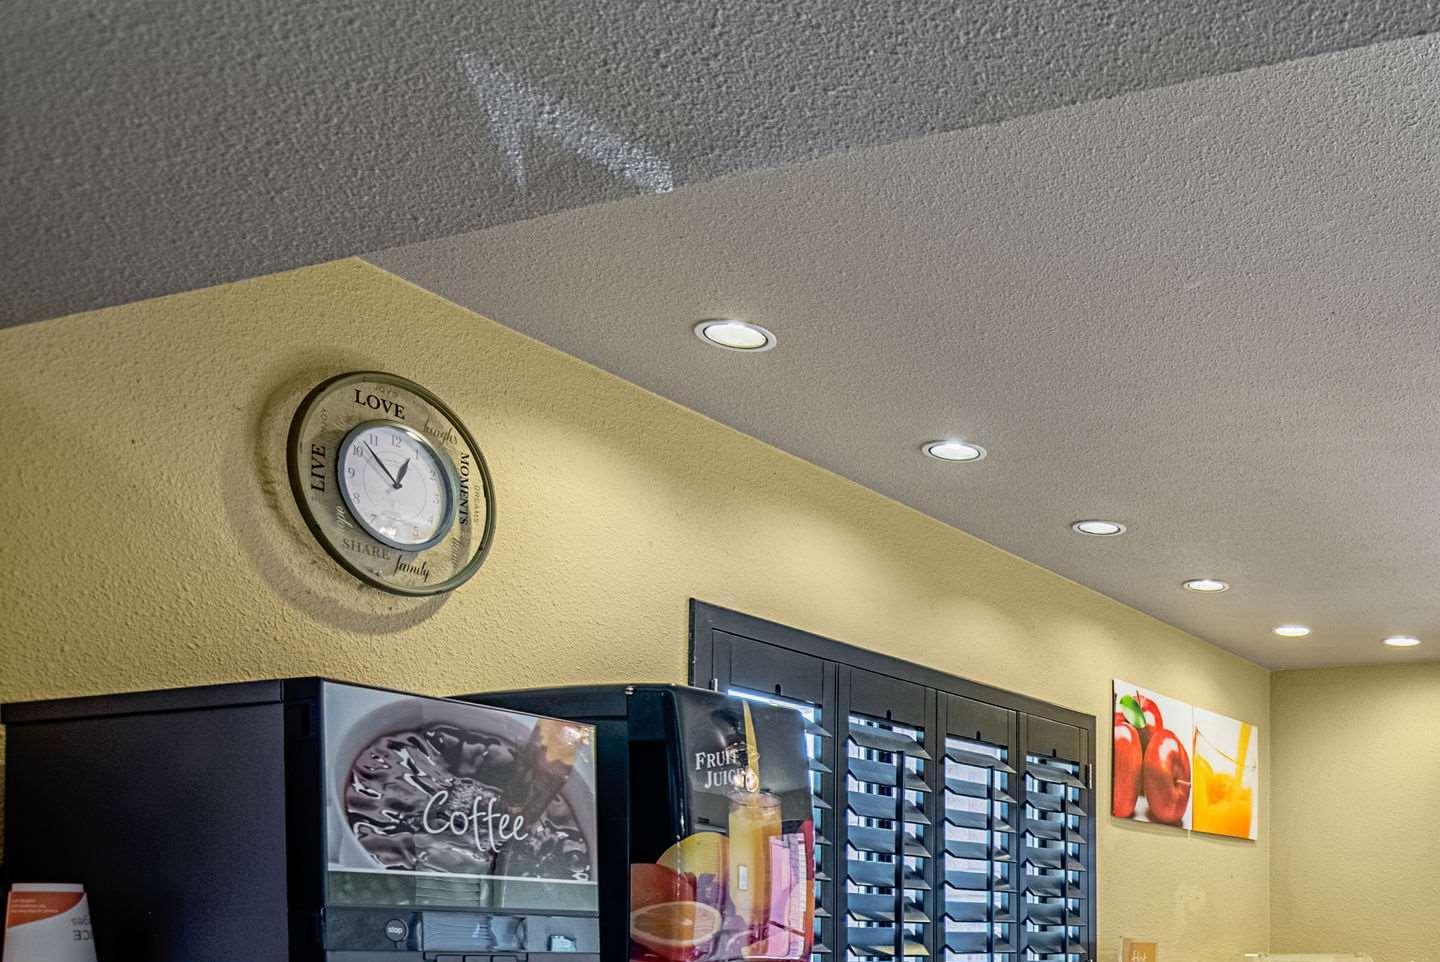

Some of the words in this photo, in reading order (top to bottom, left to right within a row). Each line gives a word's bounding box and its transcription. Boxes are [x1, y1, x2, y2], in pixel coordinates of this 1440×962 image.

[354, 389, 406, 420] LOVE
[369, 433, 379, 447] 11
[311, 443, 327, 494] LIVE
[459, 451, 471, 527] MOMENTS
[342, 537, 390, 561] SHARE
[392, 554, 431, 584] family
[695, 748, 739, 771] FRUIT
[423, 790, 529, 853] Coffee
[387, 926, 403, 935] stop
